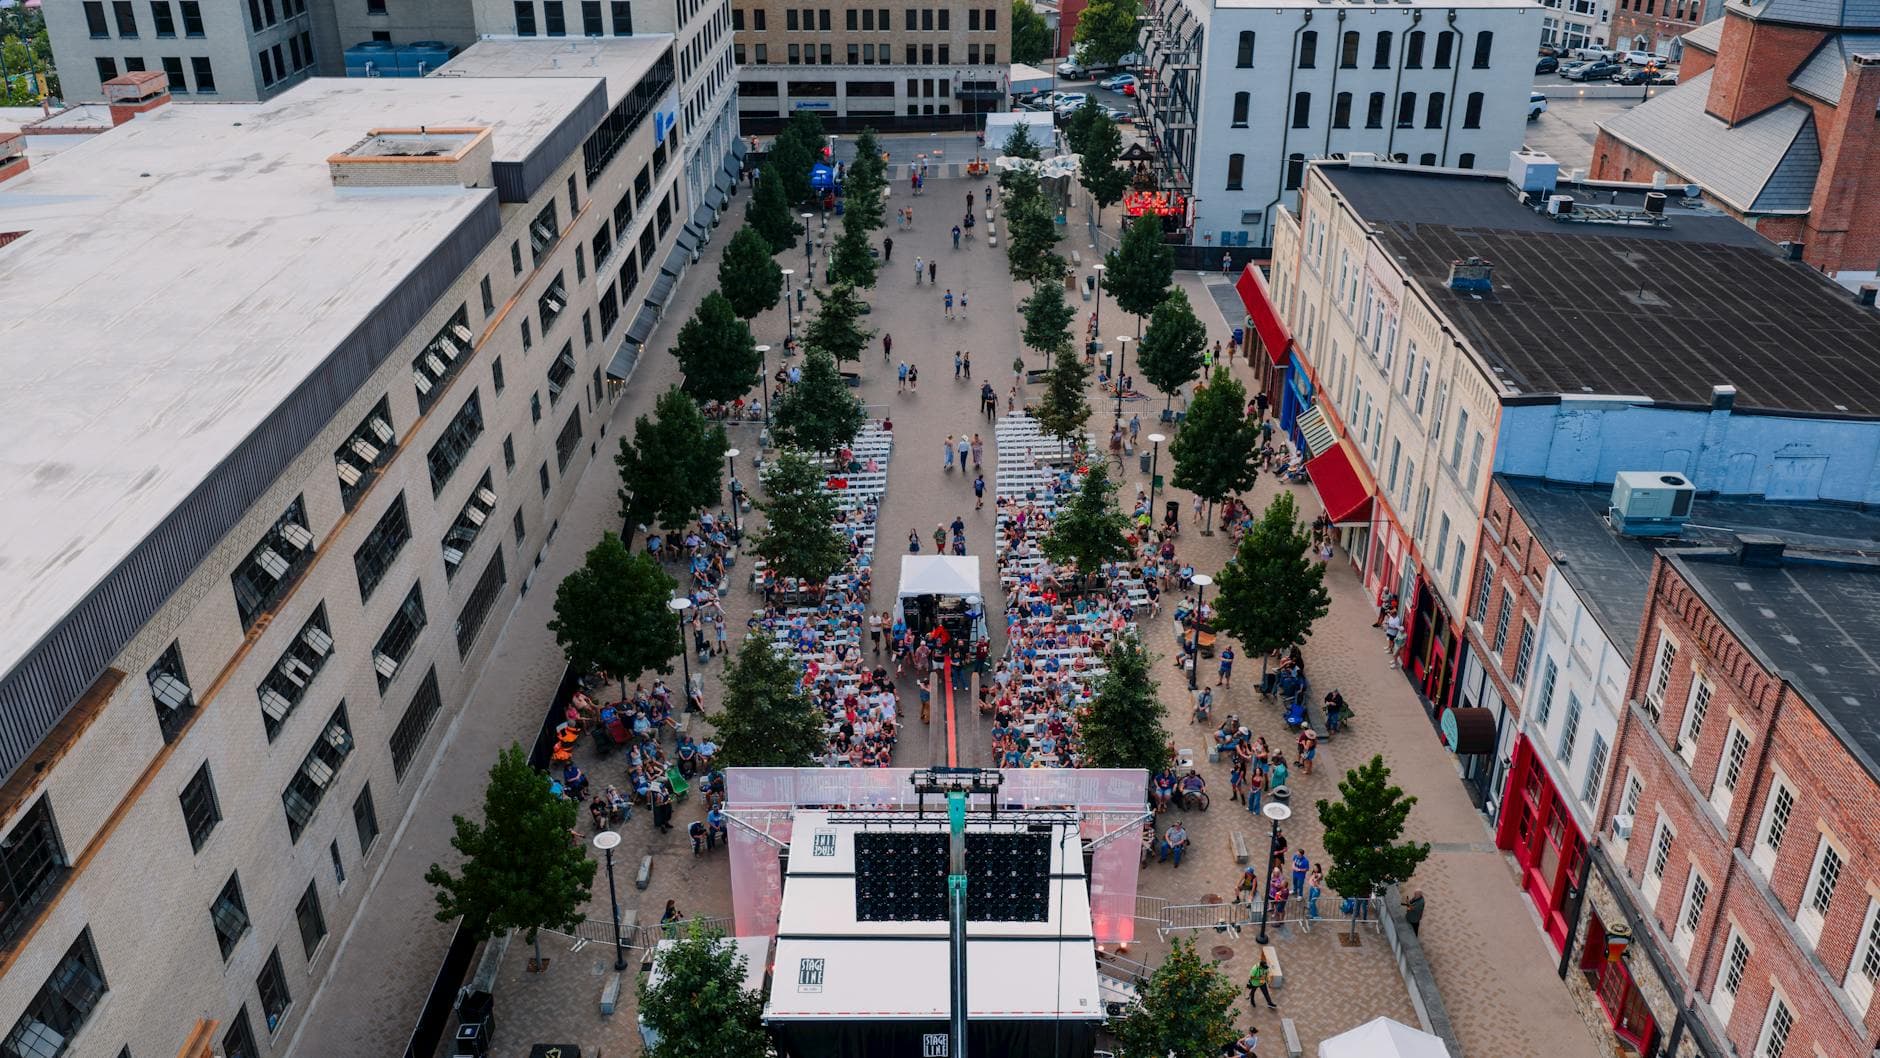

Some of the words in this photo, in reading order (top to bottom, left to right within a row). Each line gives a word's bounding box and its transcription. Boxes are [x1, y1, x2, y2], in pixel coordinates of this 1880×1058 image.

[814, 835, 836, 846] LINE
[813, 845, 835, 856] STAGE
[801, 959, 824, 971] STAGE
[800, 970, 823, 984] LINE
[925, 1035, 947, 1046] STAGE
[925, 1045, 947, 1057] LINE
